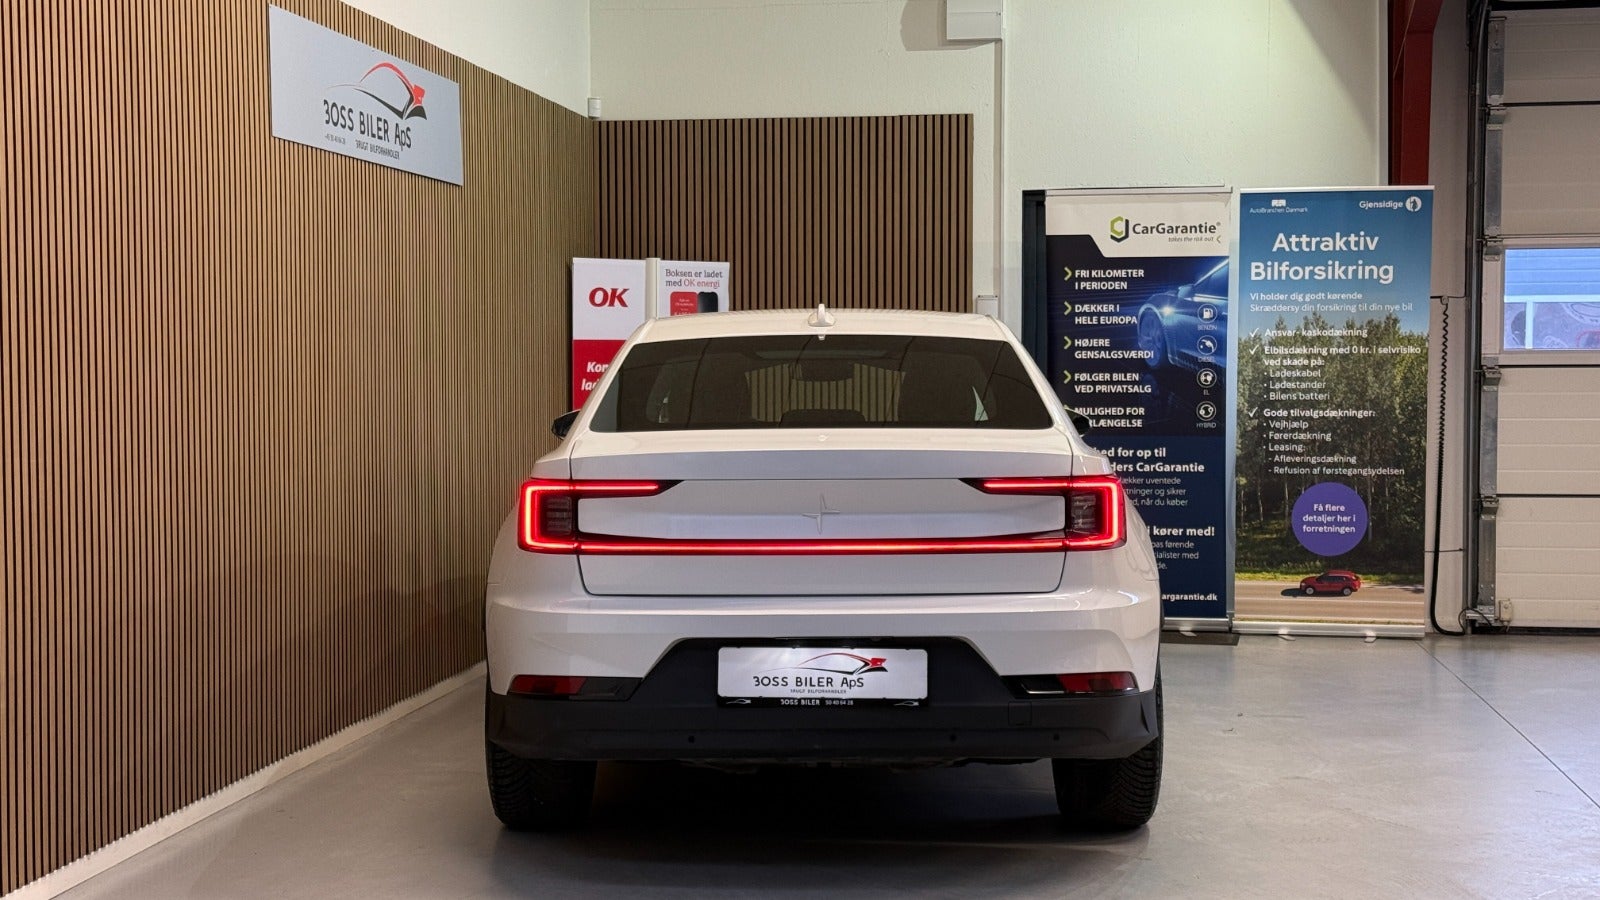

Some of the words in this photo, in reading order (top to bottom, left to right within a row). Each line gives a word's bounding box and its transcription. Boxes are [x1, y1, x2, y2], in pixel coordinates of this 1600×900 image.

[360, 111, 390, 142] BILER
[394, 122, 412, 151] ApS
[1359, 200, 1404, 210] Gjensidige
[1272, 231, 1379, 252] Attraktiv
[666, 268, 693, 278] Boksen
[704, 269, 723, 278] ladet
[1075, 269, 1090, 278] FRI
[1092, 269, 1144, 278] KILOMETER
[1250, 260, 1394, 284] Bilforsikring
[666, 279, 682, 287] med
[697, 280, 720, 289] energi
[1080, 281, 1128, 290] PERIODEN
[588, 287, 630, 308] OK
[1290, 292, 1303, 302] dig
[1305, 292, 1325, 302] godt
[1327, 292, 1362, 300] kørende
[1075, 304, 1115, 313] DÆKKER
[1250, 304, 1299, 313] Skræddersy
[1302, 304, 1314, 312] din
[1316, 303, 1356, 313] forsikring
[1369, 303, 1382, 311] din
[1402, 303, 1413, 311] bil
[1075, 316, 1098, 325] HELE
[1100, 316, 1138, 325] EUROPA
[1302, 328, 1368, 338] kaskodækning
[1075, 338, 1110, 347] HØJERE
[1075, 350, 1154, 359] GENSALGSVÆRDI
[1264, 346, 1328, 356] Elbilsdækning
[1378, 346, 1421, 354] selvrisiko
[1264, 358, 1280, 366] ved
[1282, 358, 1309, 366] skade
[1075, 373, 1111, 382] FØLGER
[1112, 373, 1139, 382] BILEN
[1270, 369, 1321, 378] Ladeskabel
[1075, 385, 1094, 393] VED
[1096, 385, 1152, 394] PRIVATSALG
[1270, 381, 1326, 389] Ladestander
[1300, 392, 1330, 400] batteri
[1075, 407, 1124, 416] MULIGHED
[1126, 407, 1145, 416] FOR
[1264, 409, 1288, 417] Gode
[1269, 420, 1308, 430] Vejhjælp
[1269, 432, 1331, 441] Førerdækning
[1118, 447, 1134, 457] for
[1136, 449, 1152, 459] op
[1154, 447, 1166, 457] til
[1274, 455, 1356, 464] Afleveringsdækning
[1136, 462, 1205, 472] CarGarantie
[1322, 467, 1404, 477] førstegangsydelsen
[1313, 503, 1324, 512] Få
[1325, 504, 1345, 512] flere
[1303, 514, 1335, 524] detaljer
[1153, 526, 1183, 536] kører
[1186, 526, 1215, 536] med!
[1303, 525, 1356, 534] forretningen
[1162, 593, 1218, 602] argarantie.dk
[795, 676, 833, 687] BILER
[840, 676, 864, 689] ApS
